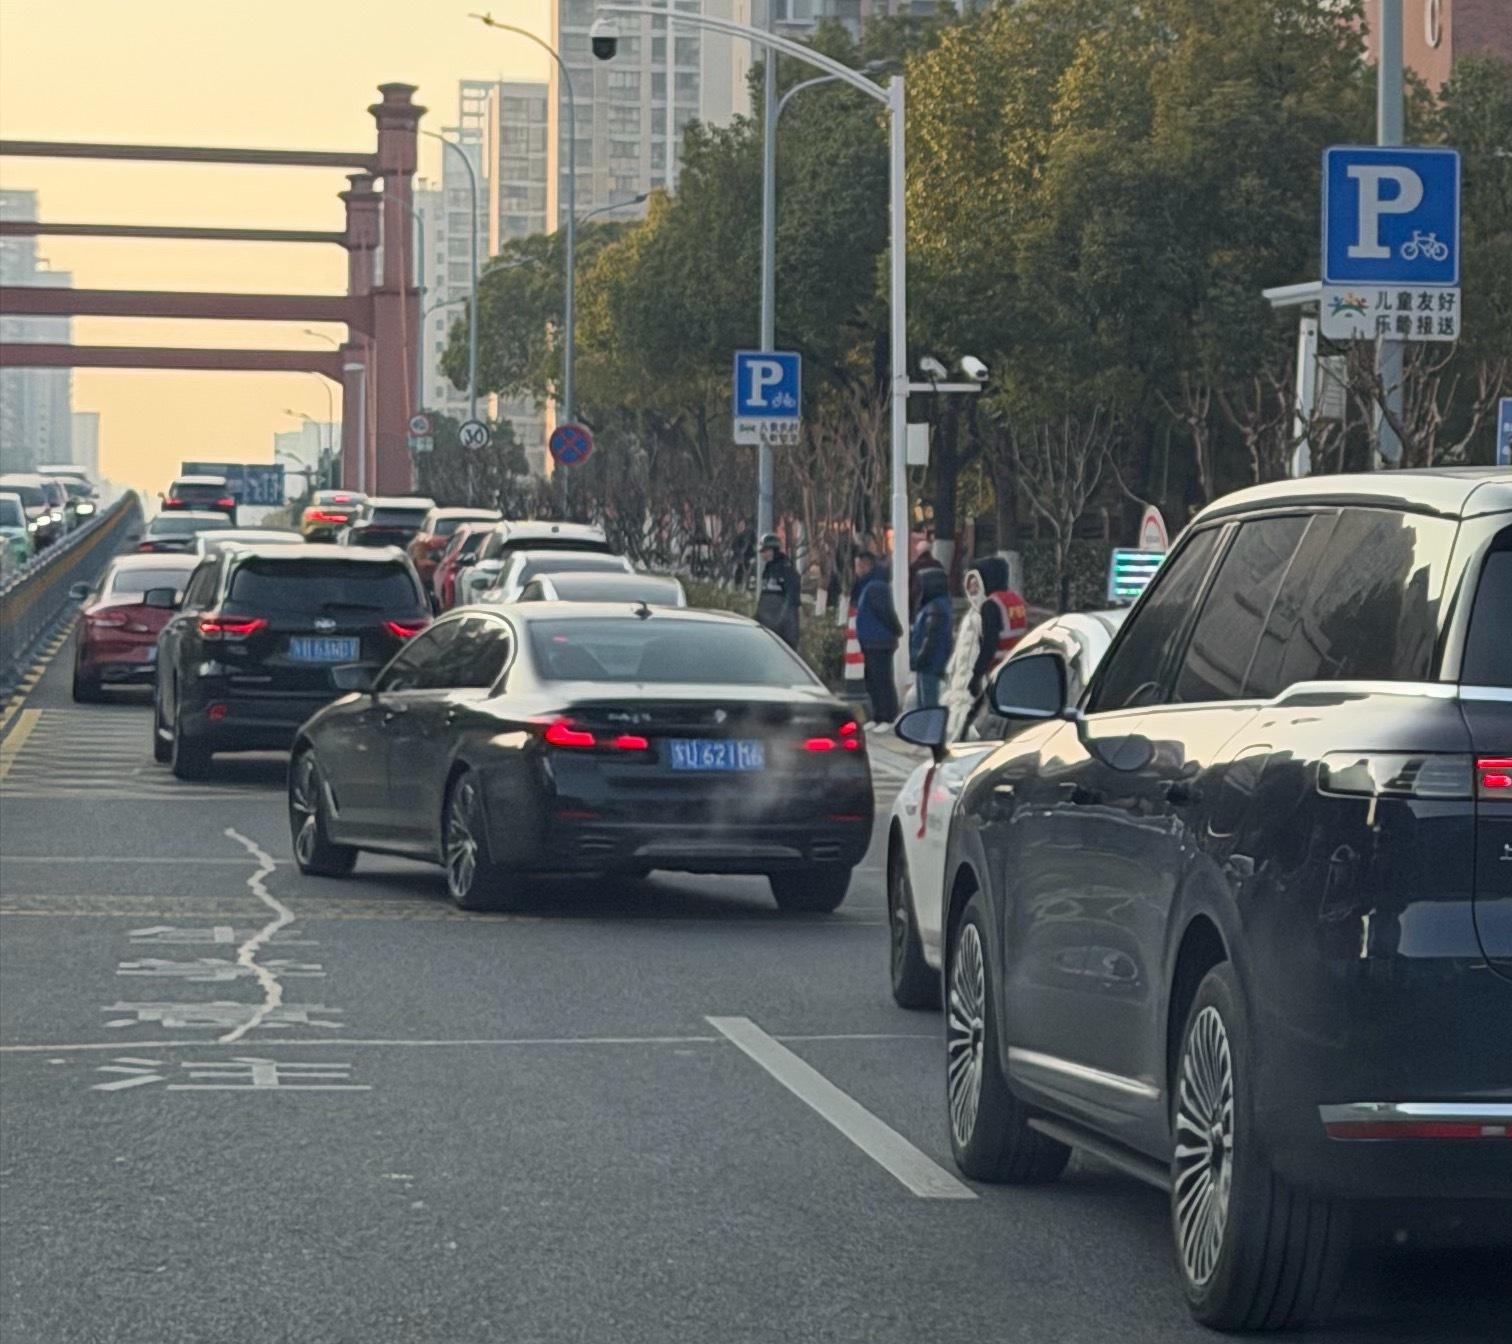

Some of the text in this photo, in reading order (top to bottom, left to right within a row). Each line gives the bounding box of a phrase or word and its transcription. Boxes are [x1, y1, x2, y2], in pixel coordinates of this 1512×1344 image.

[1347, 164, 1424, 259] P
[1374, 290, 1456, 312] 儿童友好
[746, 360, 784, 406] P
